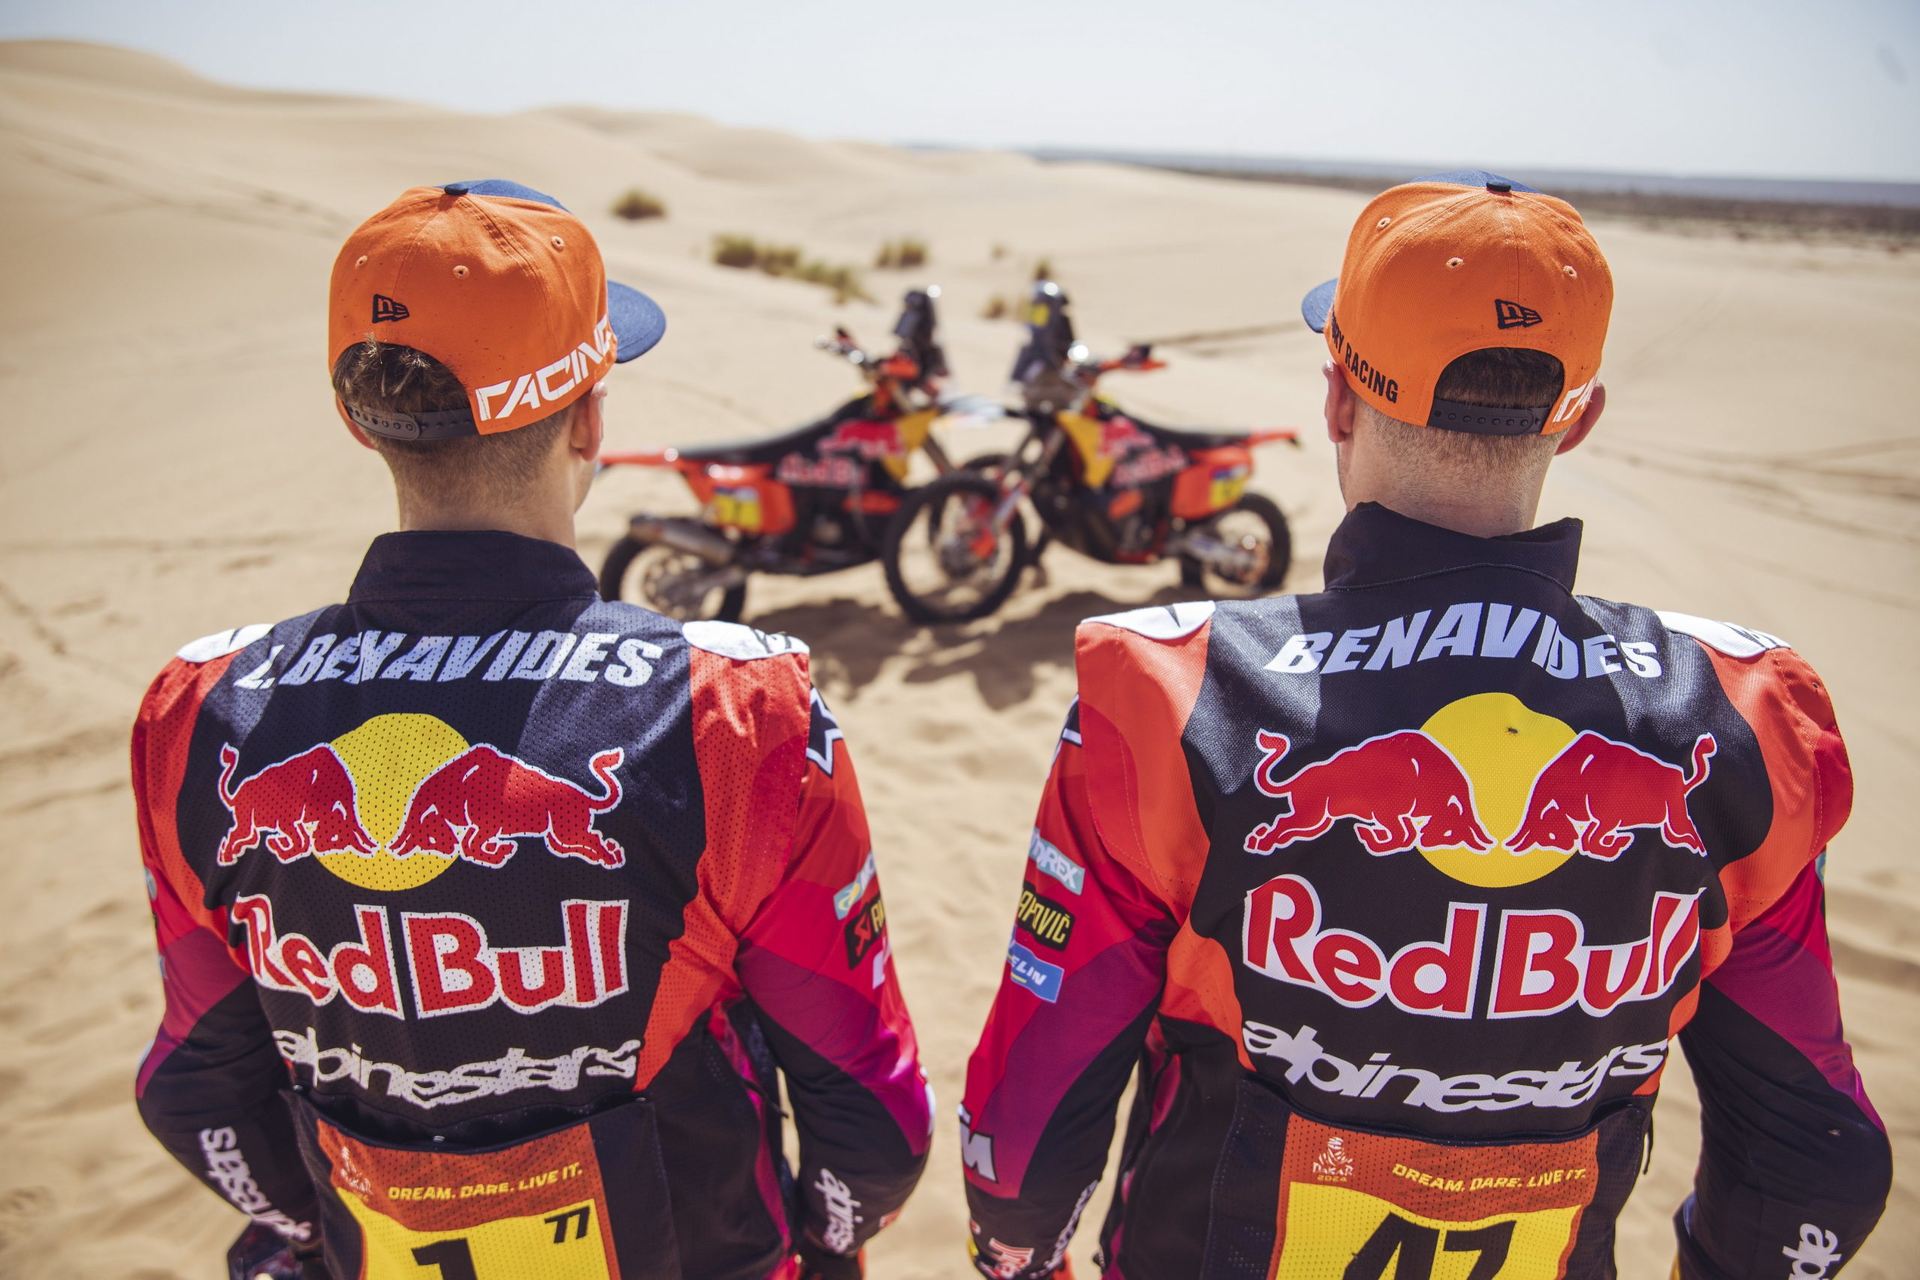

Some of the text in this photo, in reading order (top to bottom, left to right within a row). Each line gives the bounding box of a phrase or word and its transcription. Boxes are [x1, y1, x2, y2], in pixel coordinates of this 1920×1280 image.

[1345, 342, 1398, 404] RACING
[1263, 602, 1663, 680] BENAVIDES
[231, 892, 630, 1020] Red Bull
[1242, 874, 1707, 1019] Red Bull
[272, 1026, 642, 1109] alpinestars
[1242, 1020, 1668, 1112] alpinestars
[388, 1186, 456, 1200] DREAM.
[460, 1183, 514, 1199] DARE.
[519, 1169, 558, 1191] LIVE
[562, 1161, 583, 1180] IT.
[1392, 1163, 1465, 1192] DREAM.
[1469, 1177, 1522, 1191] DARE.
[1527, 1169, 1564, 1188] LIVE
[544, 1206, 590, 1244] 77
[1341, 1211, 1517, 1280] 47
